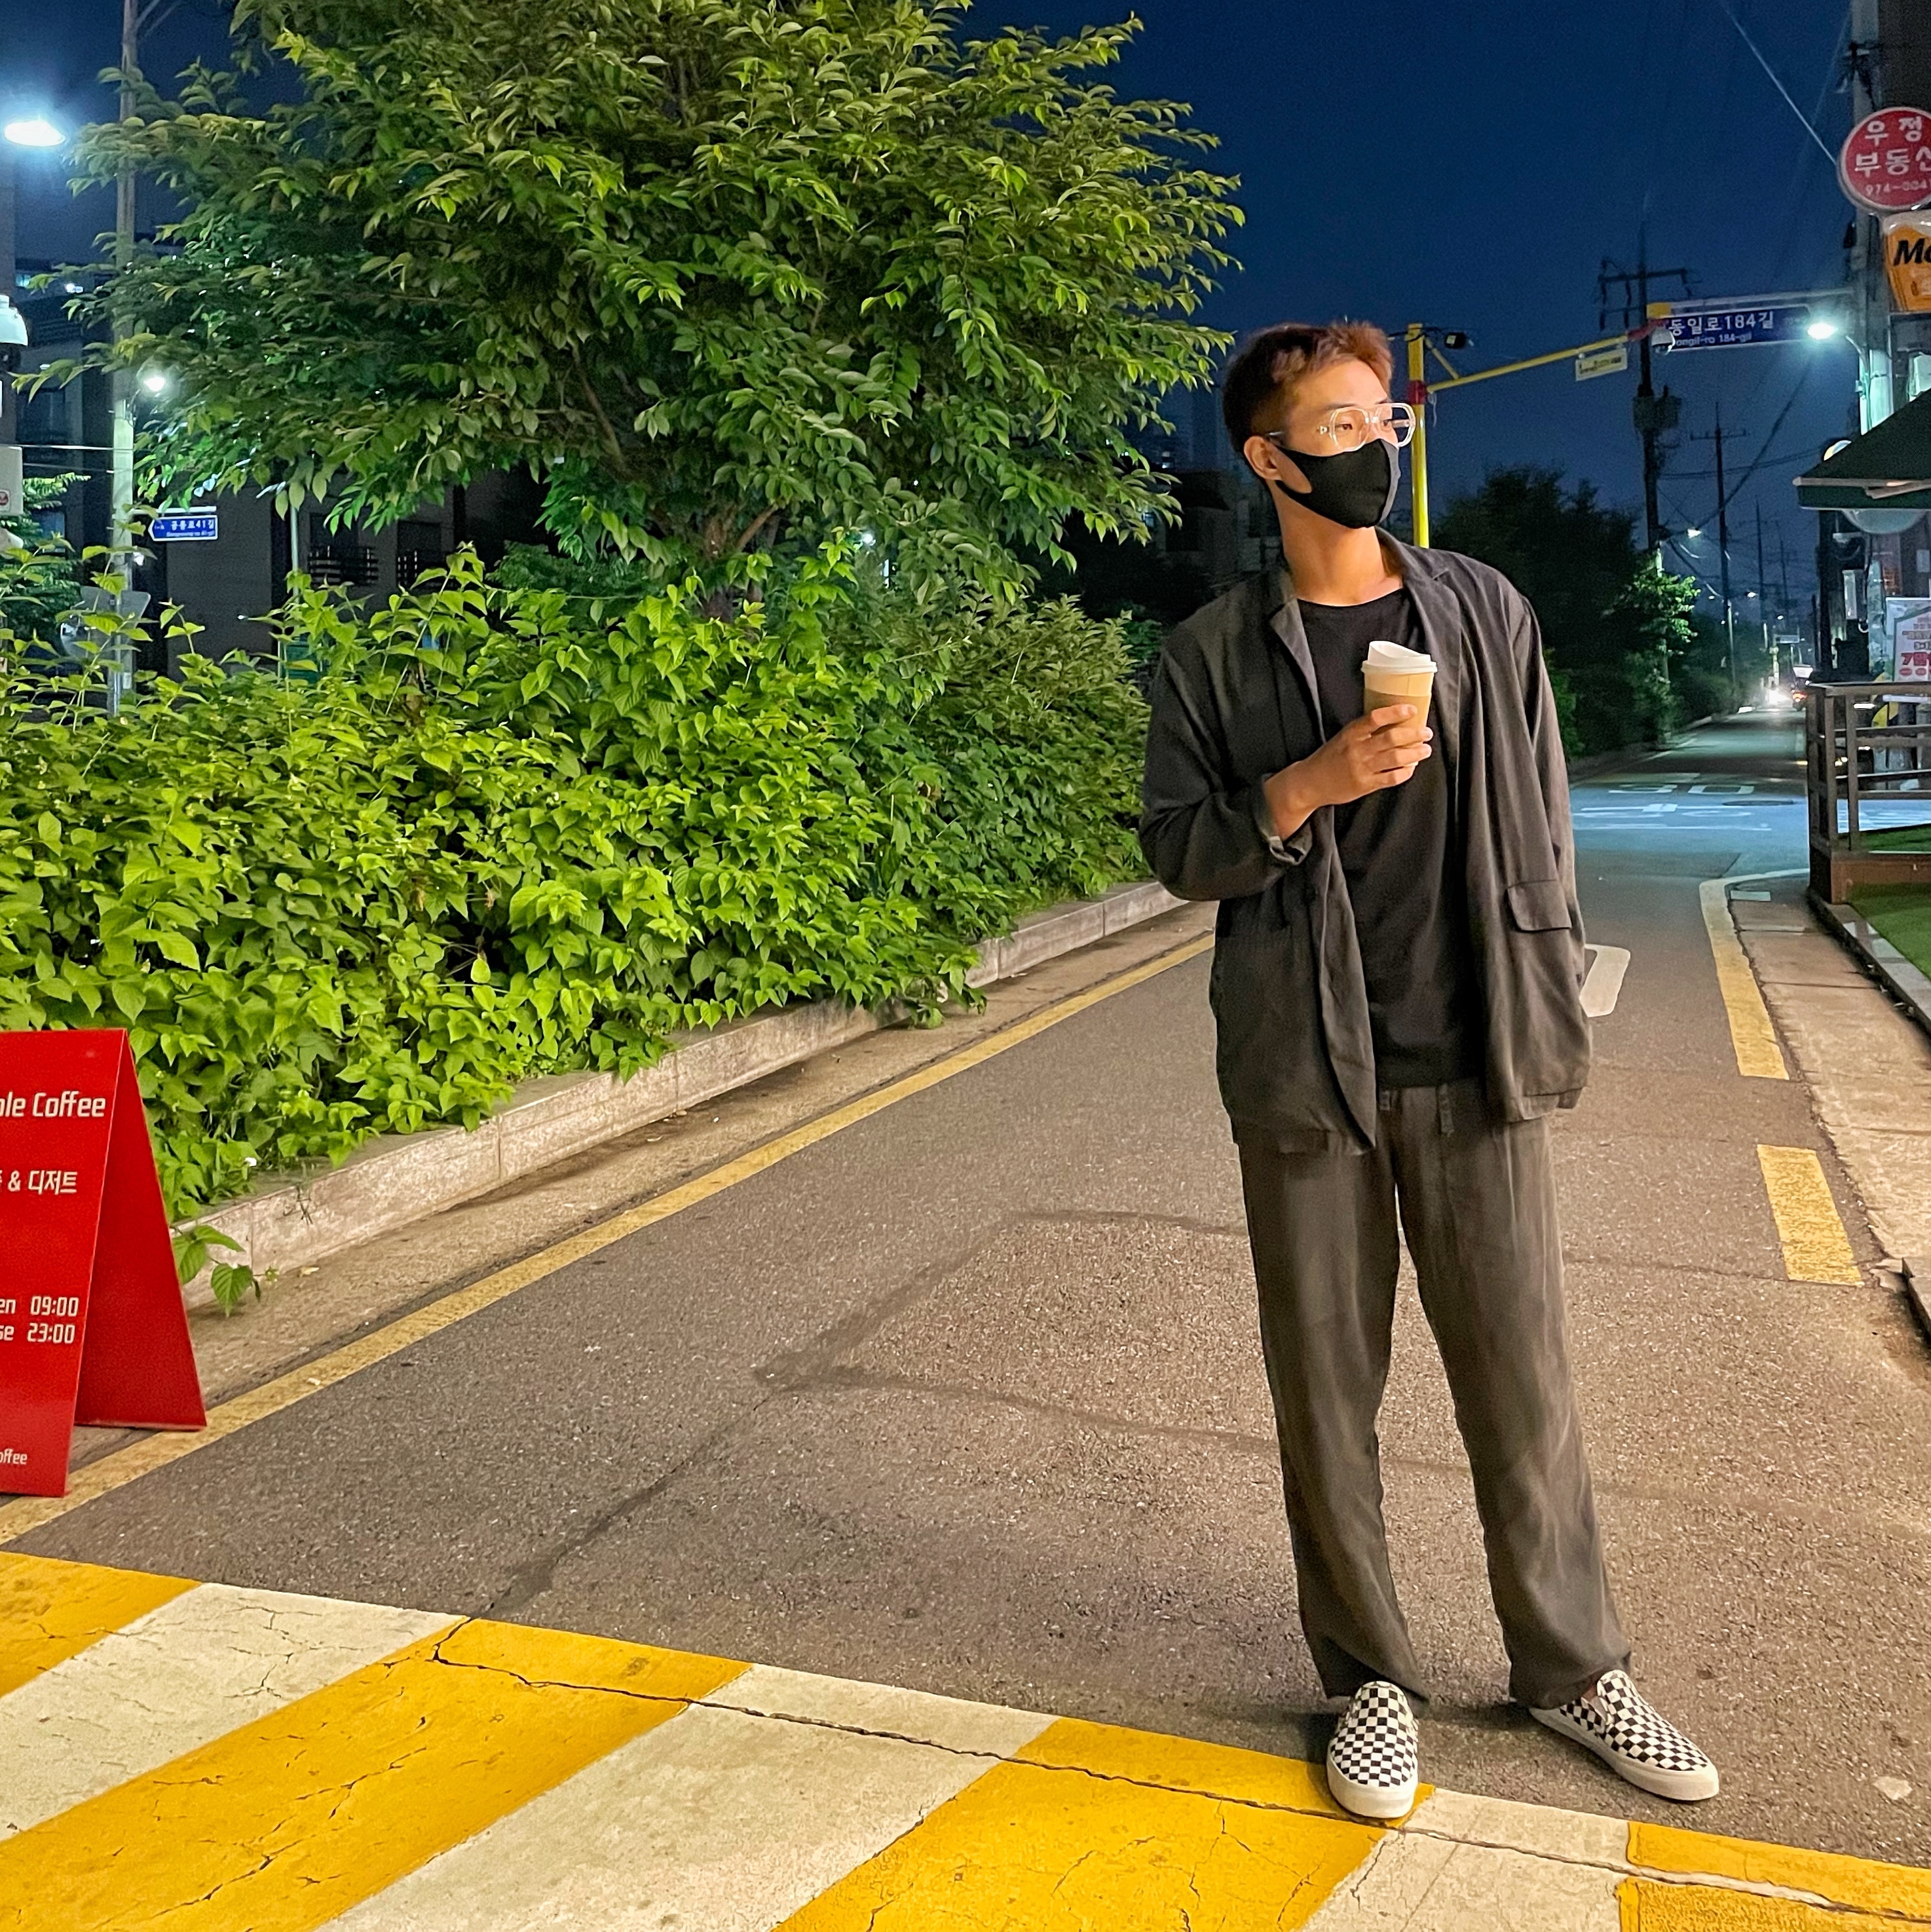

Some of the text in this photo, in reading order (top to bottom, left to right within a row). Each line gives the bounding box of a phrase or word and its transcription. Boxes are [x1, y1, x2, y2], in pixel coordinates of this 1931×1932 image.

[1864, 115, 1922, 147] 우정
[1668, 311, 1774, 337] 동일로184길
[1675, 335, 1715, 347] ongil-ro
[32, 1091, 106, 1118] Coffee
[8, 1169, 21, 1192] &
[28, 1169, 78, 1195] 디저트
[30, 1296, 79, 1317] 09:00
[27, 1322, 75, 1344] 23:00
